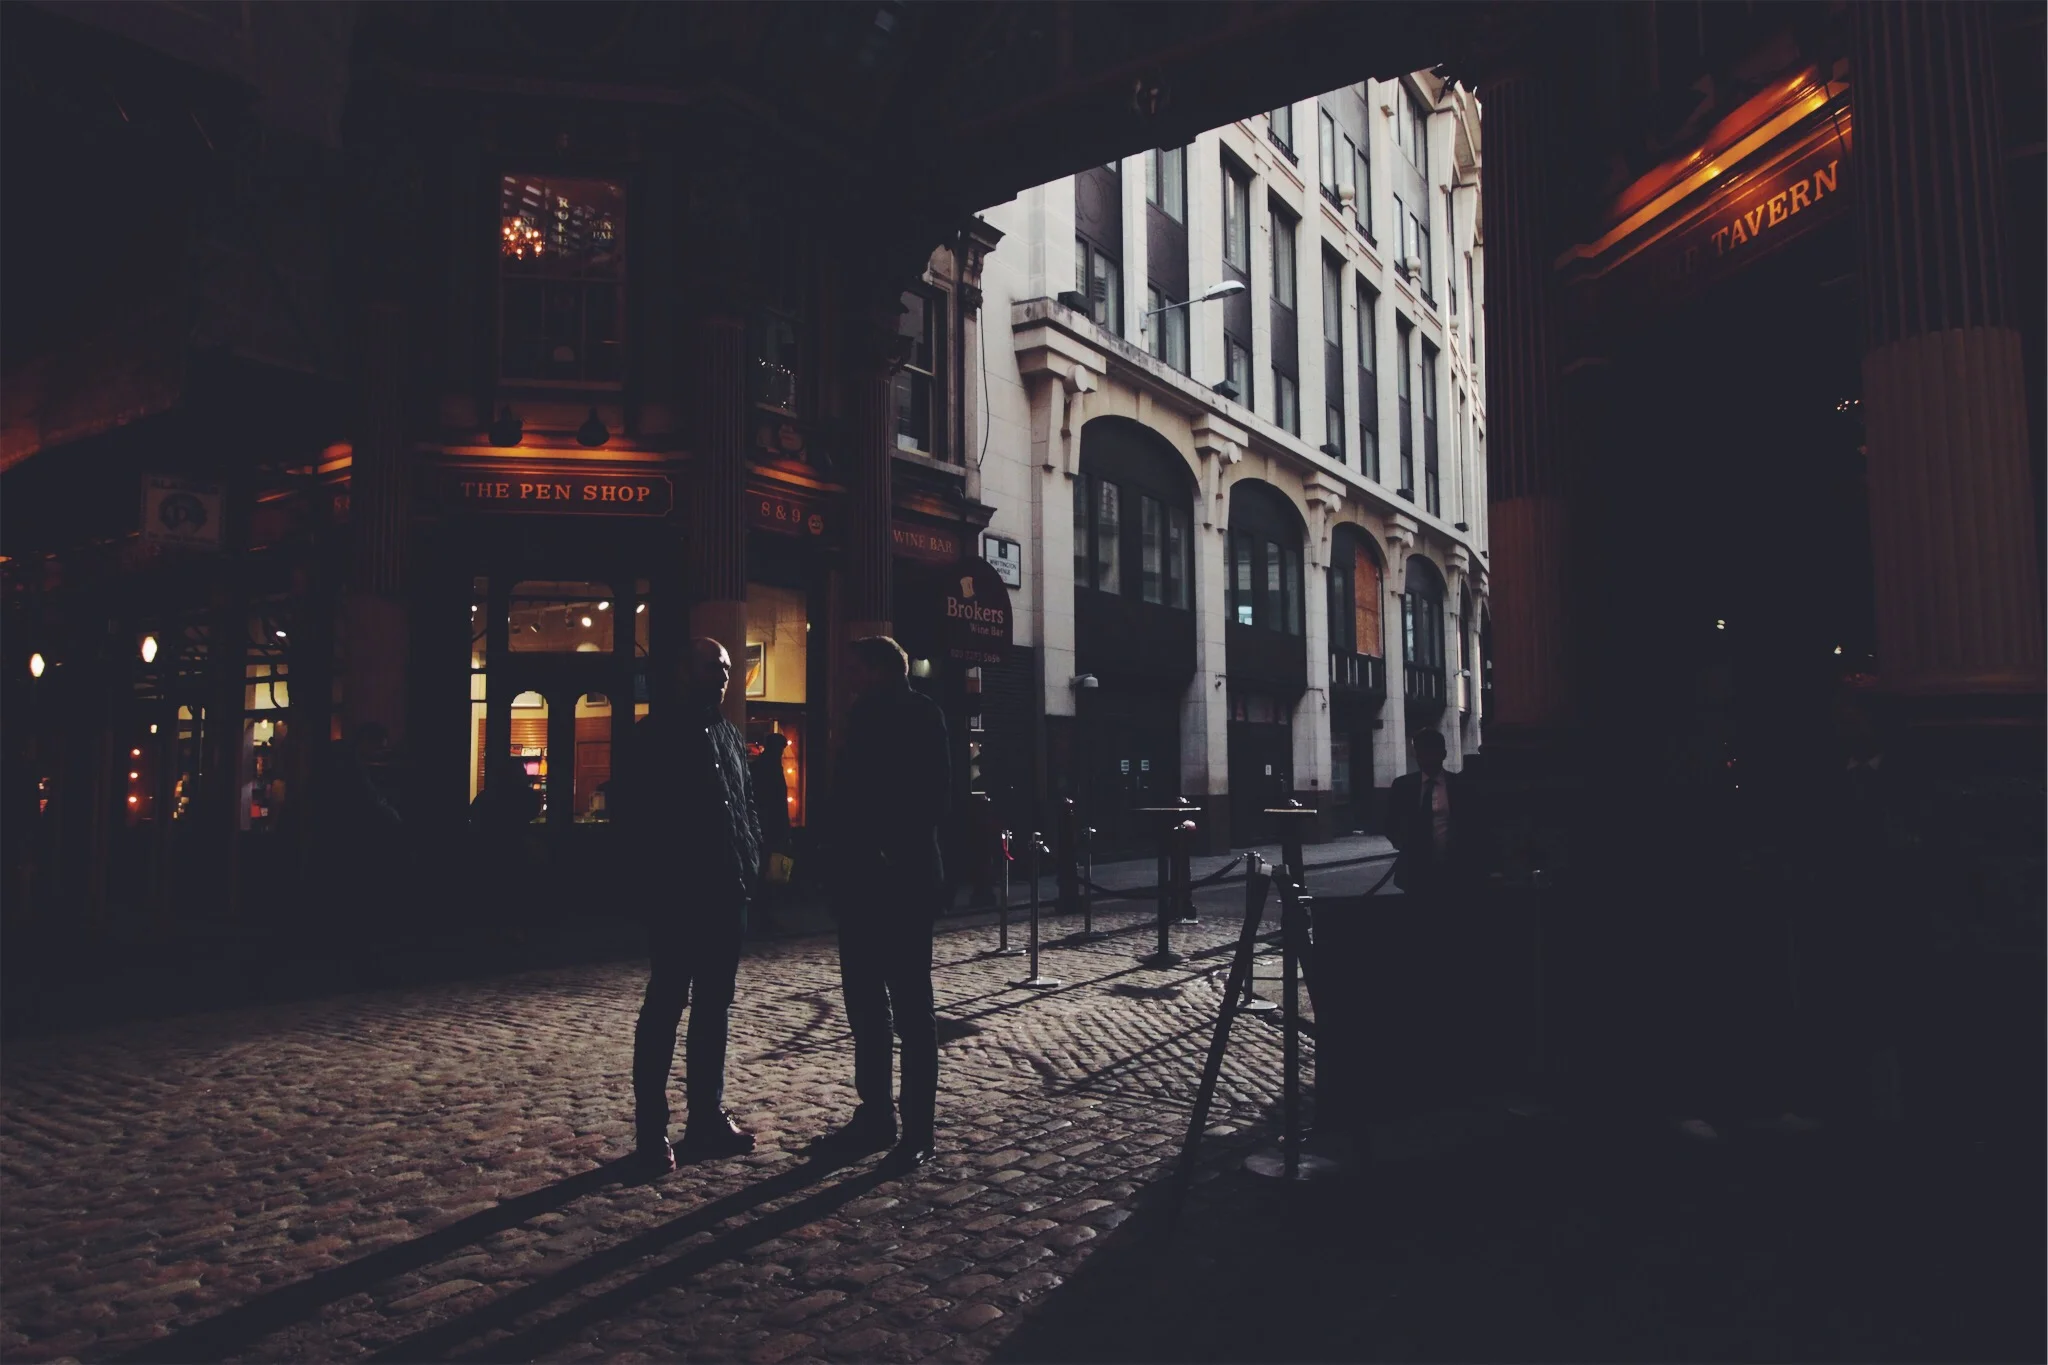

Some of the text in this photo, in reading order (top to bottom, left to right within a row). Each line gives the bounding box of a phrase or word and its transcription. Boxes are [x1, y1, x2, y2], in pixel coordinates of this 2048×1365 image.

[1710, 159, 1838, 258] TAVERN
[460, 482, 651, 502] THE PEN SHOP
[761, 501, 801, 523] 8 & 9
[893, 529, 954, 553] WINE BAR
[946, 596, 1004, 624] Brokers
[969, 622, 1004, 637] Wine Bar
